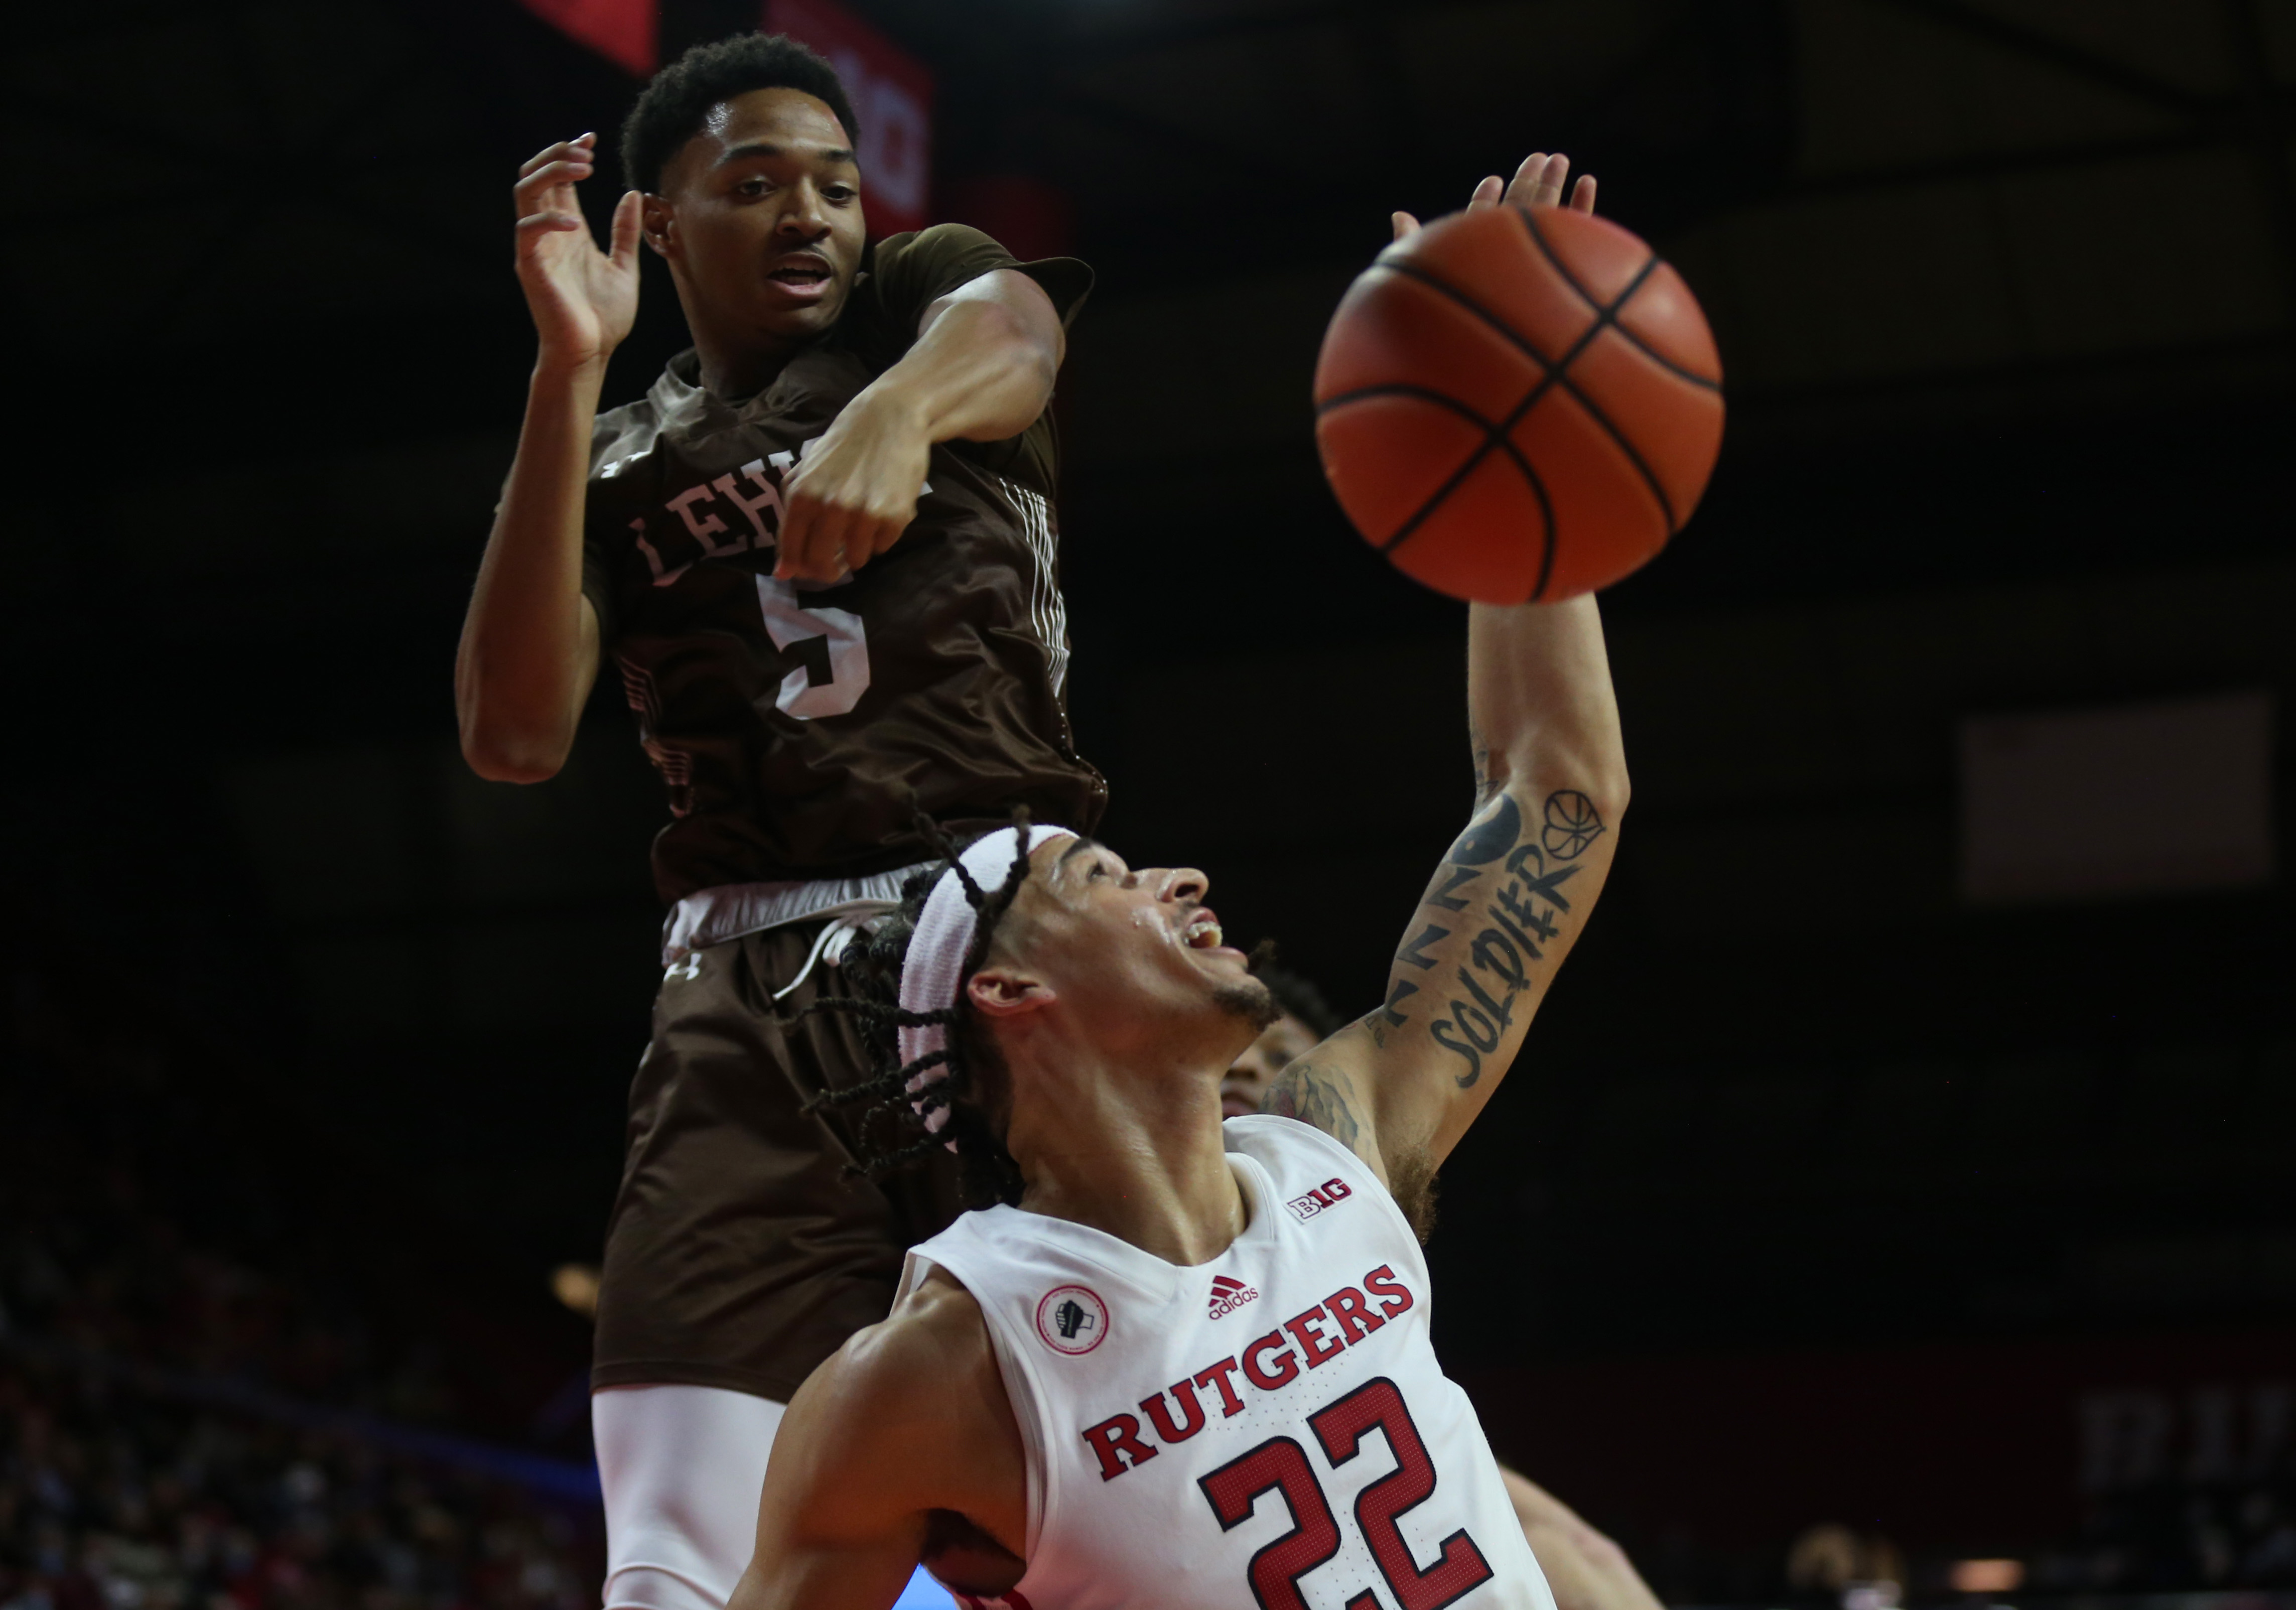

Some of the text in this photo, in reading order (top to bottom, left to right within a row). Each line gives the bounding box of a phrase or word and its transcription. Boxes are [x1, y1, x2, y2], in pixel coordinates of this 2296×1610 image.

[755, 572, 871, 721] 5
[1430, 843, 1584, 1089] SOLDIER
[1082, 1264, 1414, 1483] RUTGERS
[1208, 1287, 1259, 1320] adidas
[1197, 1376, 1495, 1610] 22
